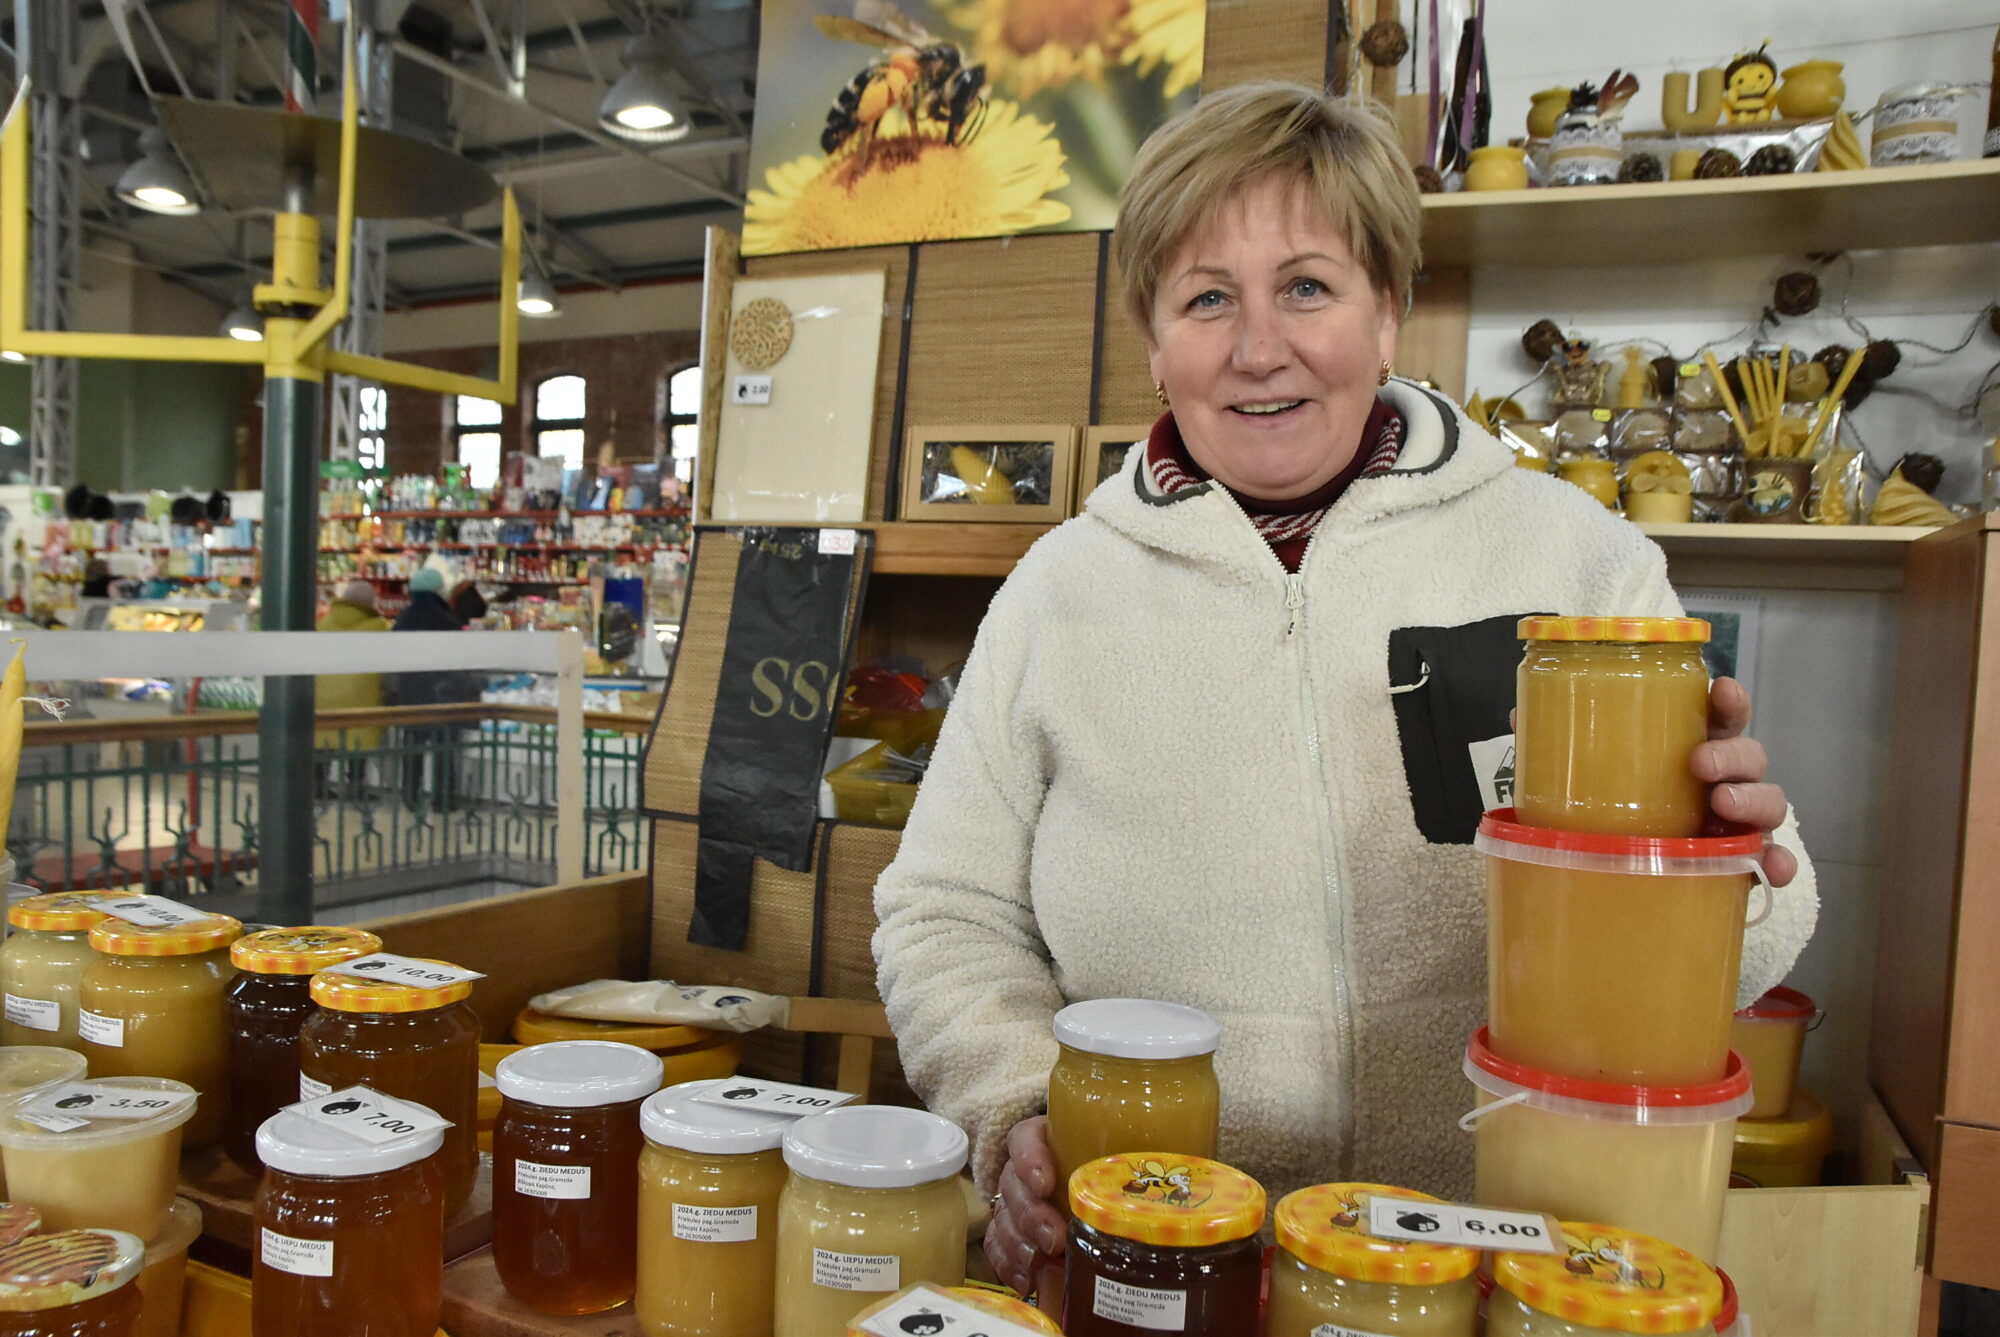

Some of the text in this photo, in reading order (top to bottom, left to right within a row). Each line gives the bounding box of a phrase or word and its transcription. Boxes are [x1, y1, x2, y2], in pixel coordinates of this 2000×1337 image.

[398, 967, 456, 982] 10,00
[110, 1099, 170, 1109] 3,50
[774, 1094, 831, 1107] 7,00
[363, 1112, 415, 1134] 7,00
[726, 1208, 752, 1216] MEDUS
[1465, 1220, 1541, 1238] 6,00
[300, 1242, 326, 1250] MEDUS
[843, 1256, 863, 1264] LIEPU
[866, 1257, 893, 1265] MEDUS
[1125, 1288, 1148, 1297] ZIEDU
[1150, 1293, 1180, 1301] MEDUS
